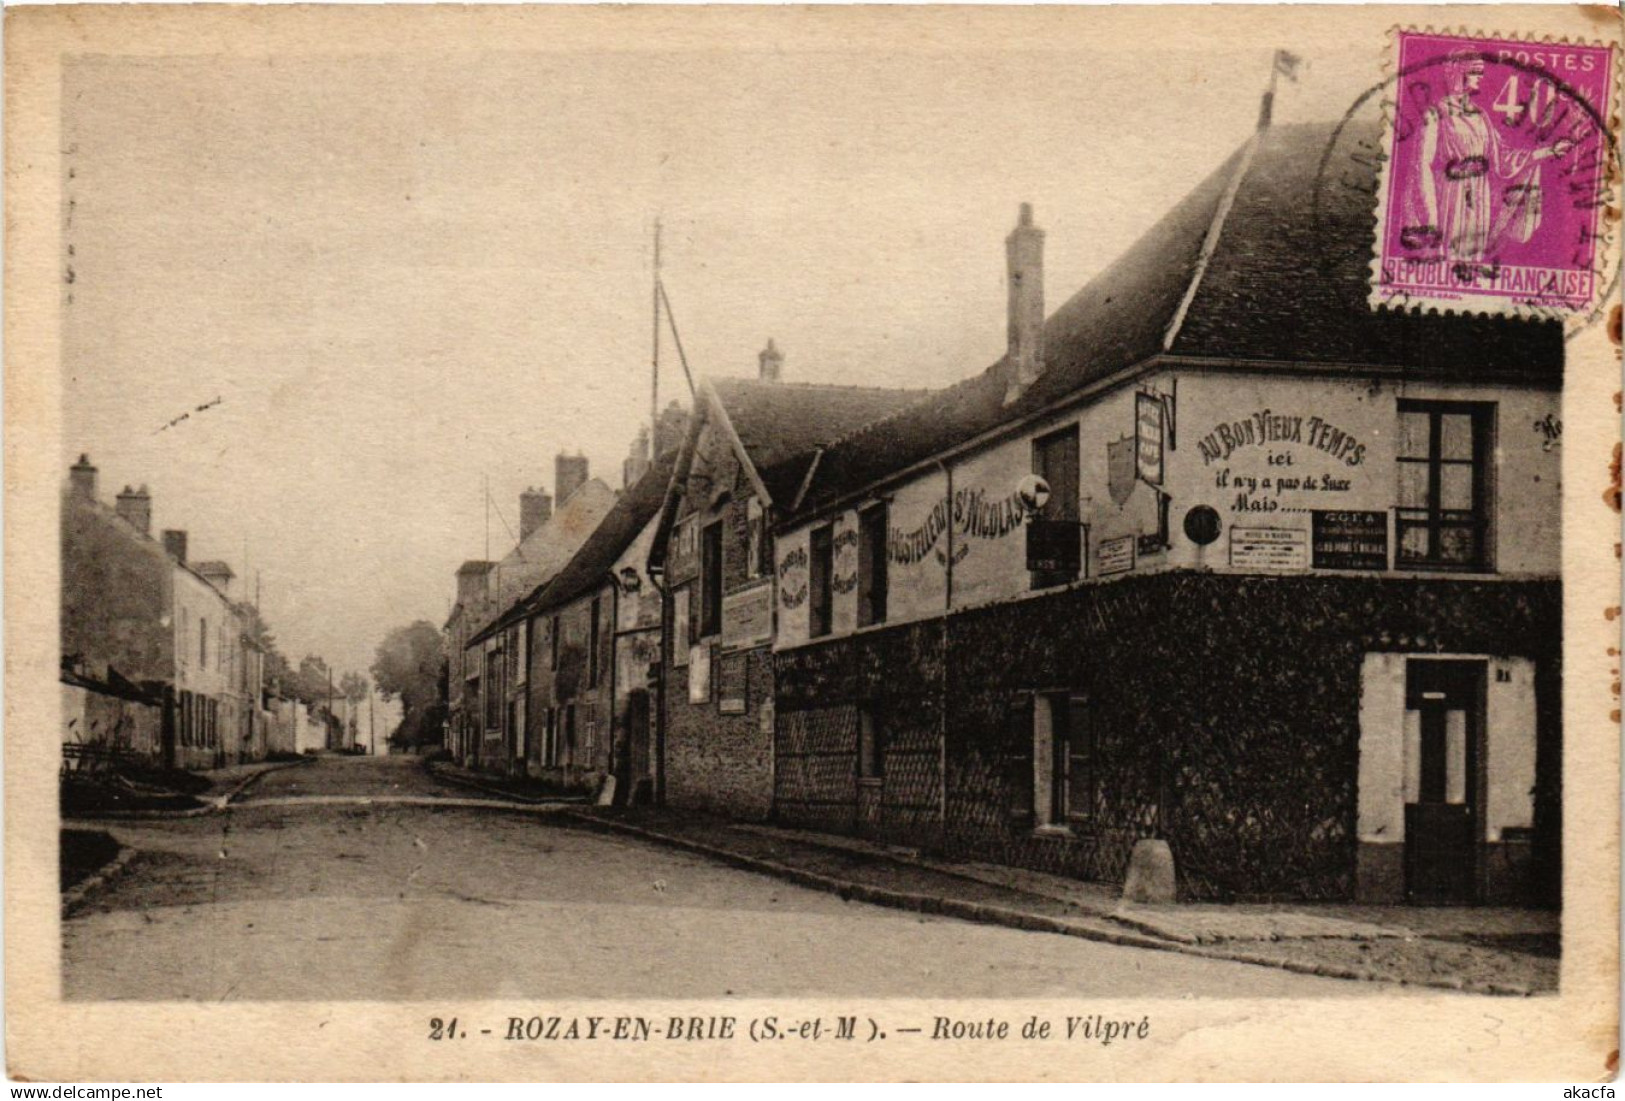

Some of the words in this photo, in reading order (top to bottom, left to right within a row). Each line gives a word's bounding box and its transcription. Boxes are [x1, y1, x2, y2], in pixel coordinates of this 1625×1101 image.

[1499, 49, 1595, 72] POSTES
[428, 1017, 467, 1039] 21.
[504, 1016, 737, 1041] ROZAY-EN-BRIE
[931, 1016, 1010, 1040] Route
[1021, 1016, 1051, 1040] de
[1066, 1015, 1150, 1046] Vilpré
